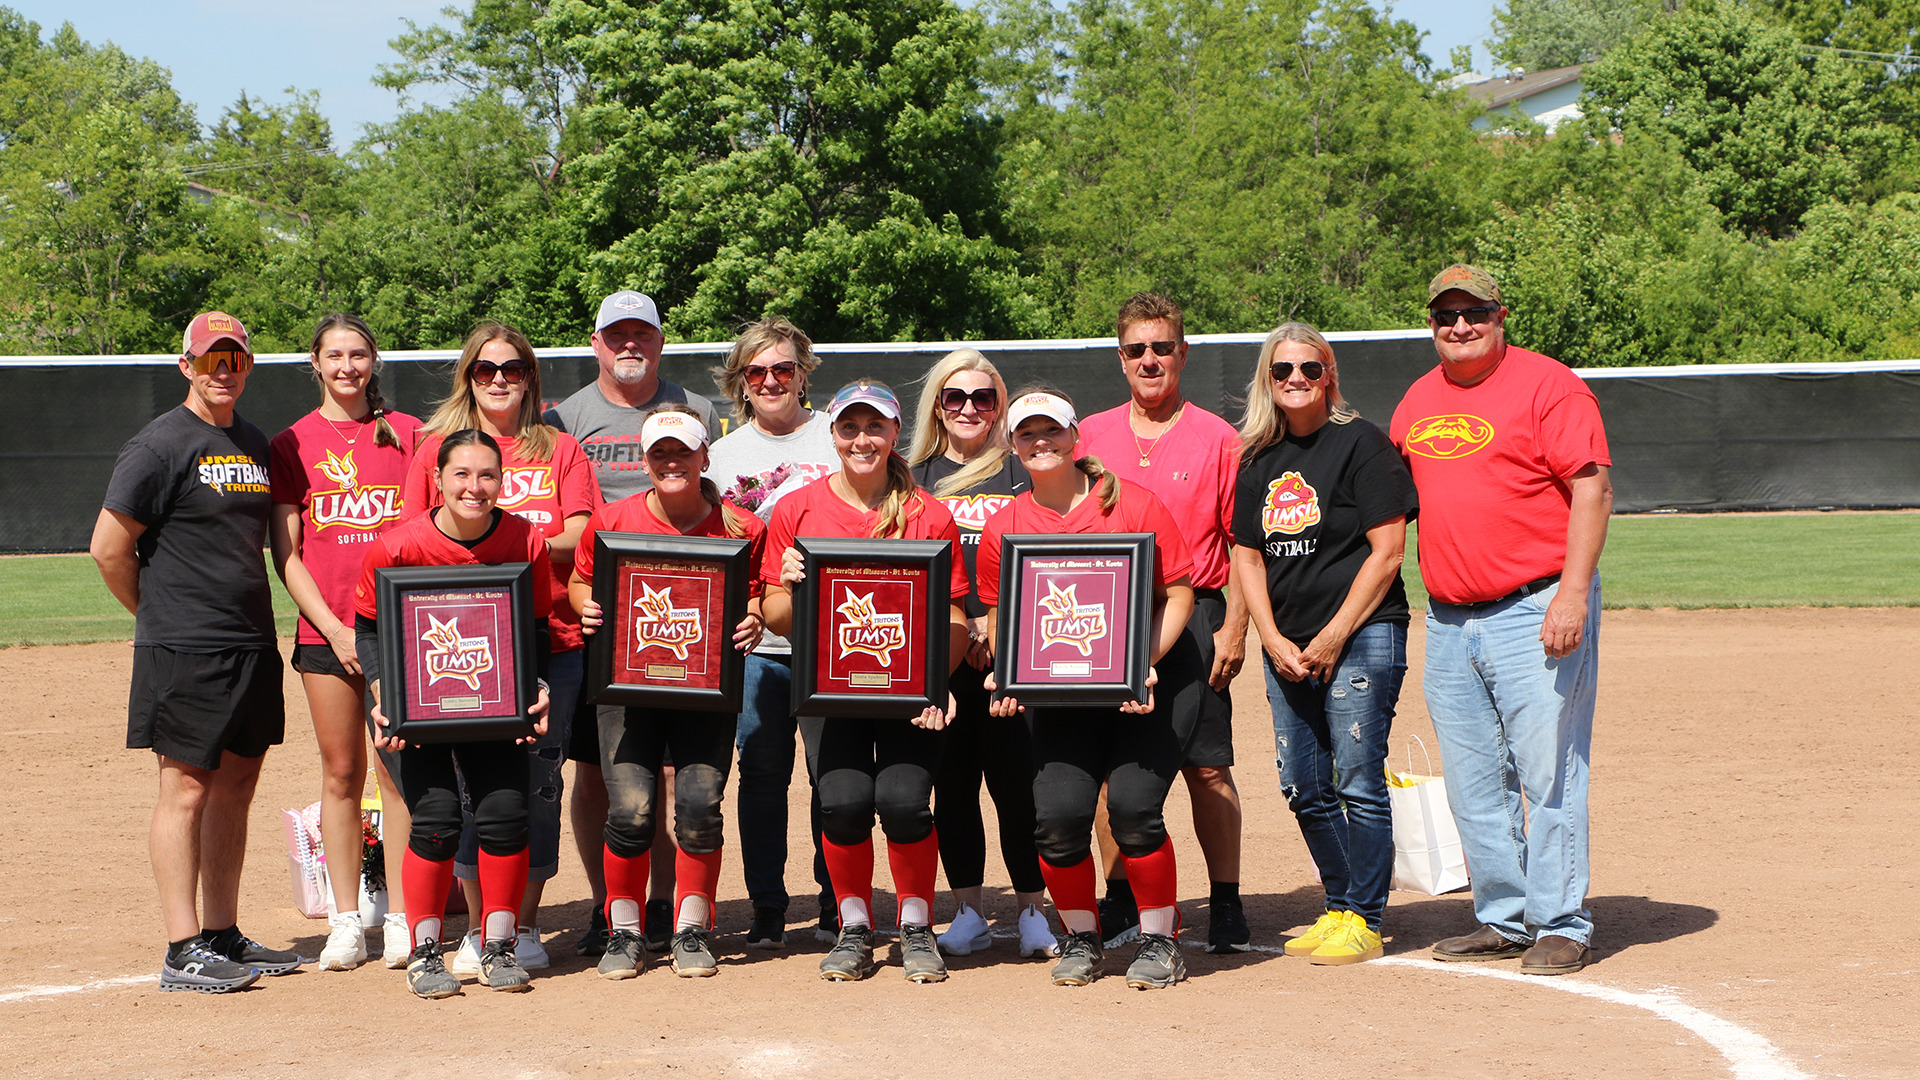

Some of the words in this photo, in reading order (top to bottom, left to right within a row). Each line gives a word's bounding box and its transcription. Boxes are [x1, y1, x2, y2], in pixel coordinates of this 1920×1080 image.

[584, 434, 642, 444] UMS
[198, 455, 256, 465] UMSL
[583, 443, 644, 462] SOFT
[198, 463, 271, 486] SOFTBALL
[223, 482, 271, 494] TRITONS
[313, 489, 401, 526] UMSL
[1265, 502, 1317, 529] UMSL
[337, 531, 382, 545] SOFTBA
[643, 622, 697, 643] UMSL
[845, 627, 901, 649] UMSL
[1047, 617, 1103, 639] UMSL
[432, 651, 488, 673] UMSL
